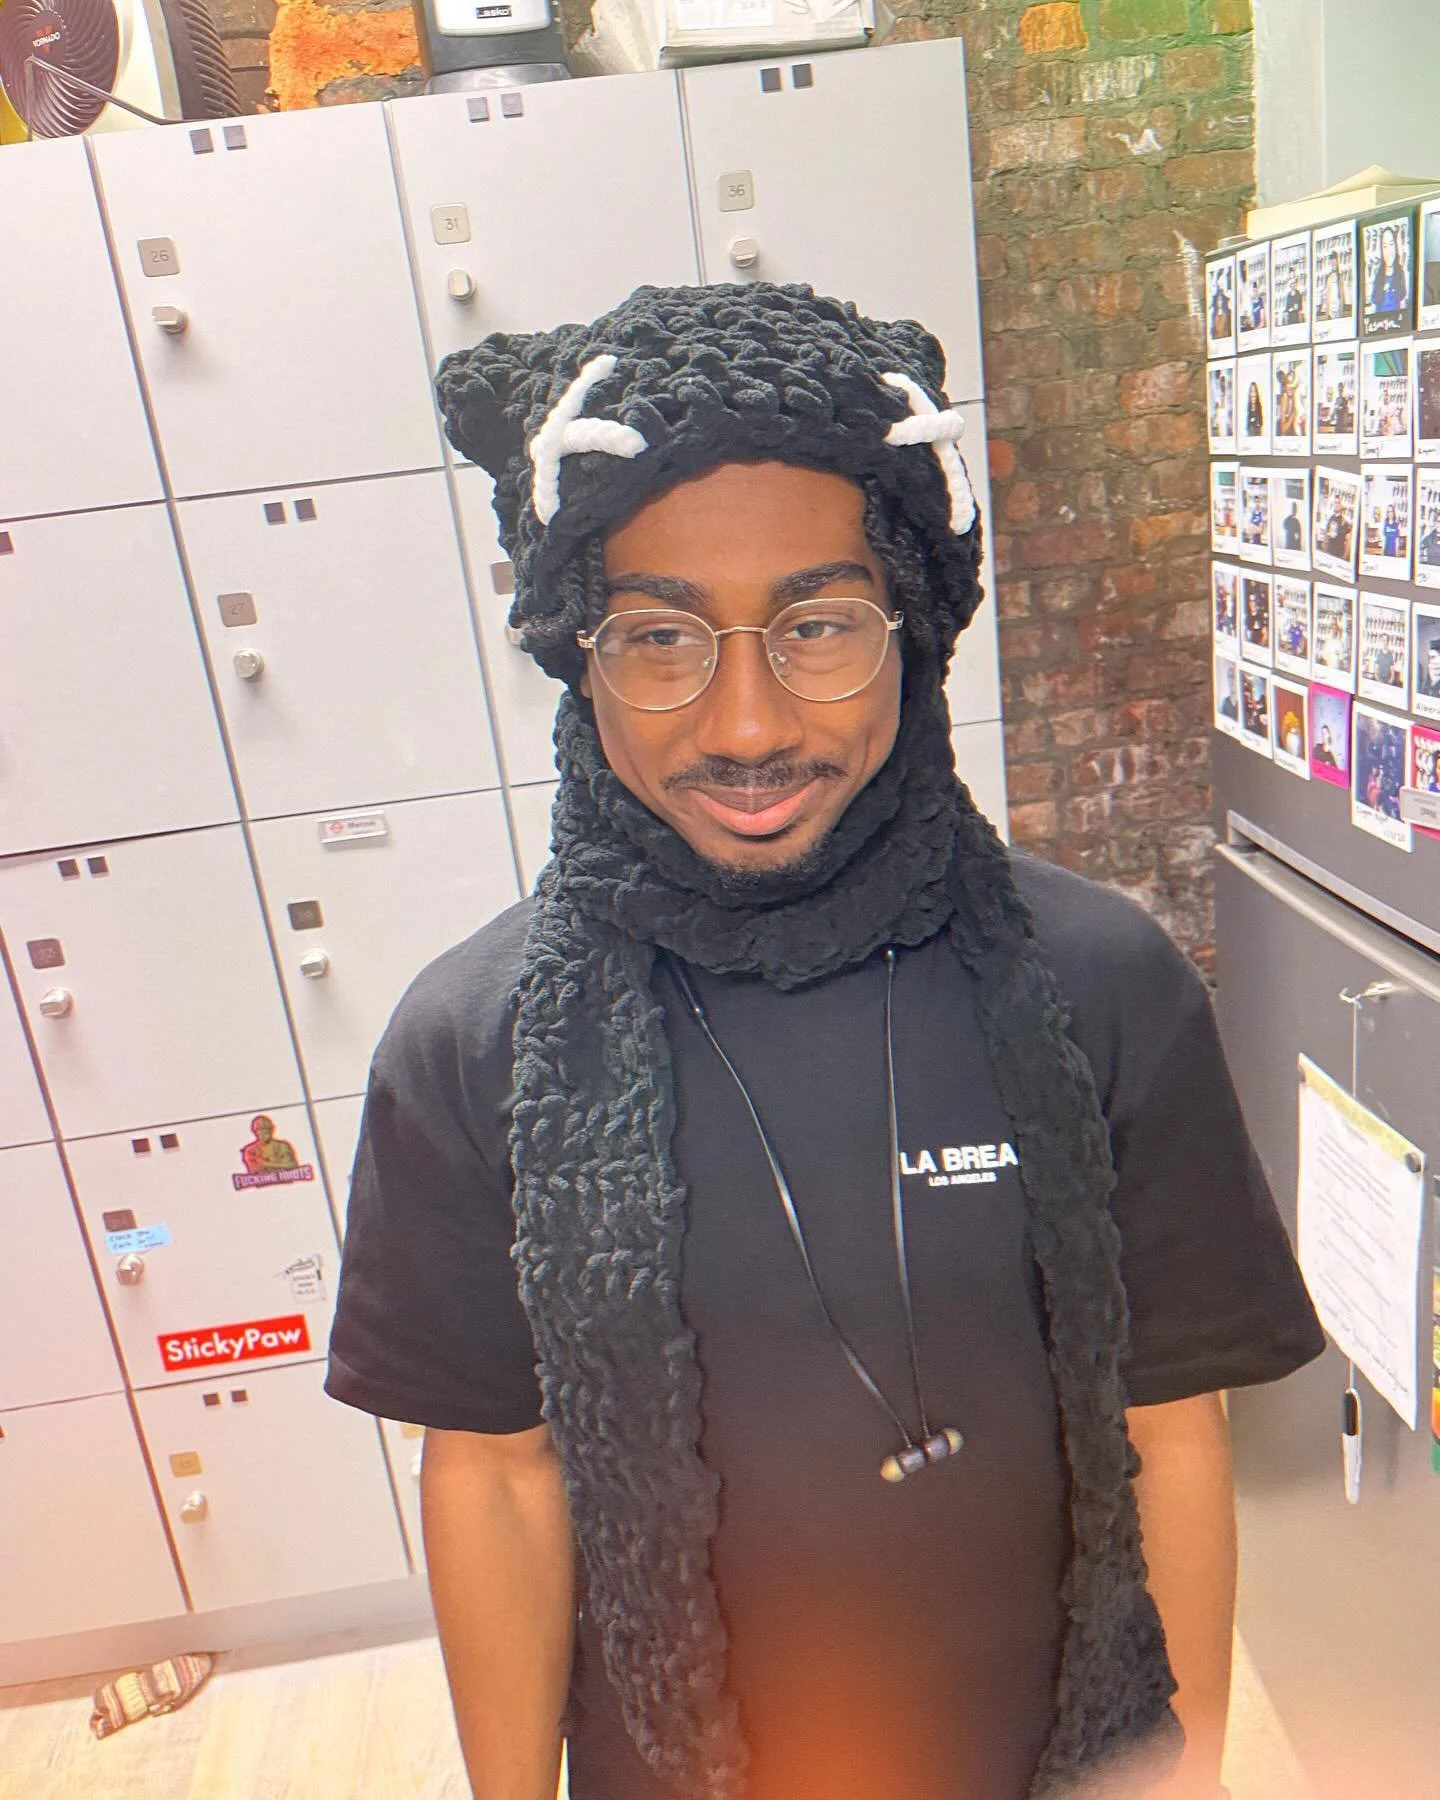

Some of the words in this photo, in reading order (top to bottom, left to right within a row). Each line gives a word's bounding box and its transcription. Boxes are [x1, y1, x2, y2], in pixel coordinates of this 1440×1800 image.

[727, 183, 746, 198] 36
[443, 217, 459, 232] 31
[150, 248, 169, 264] 26
[899, 1150, 938, 1175] LA
[941, 1142, 1019, 1172] BREA
[234, 1172, 277, 1189] FUCKING
[279, 1166, 313, 1182] IDIOTS
[928, 1175, 949, 1187] LOS
[950, 1171, 997, 1185] ANGELES
[165, 1327, 302, 1363] StickyPaw
